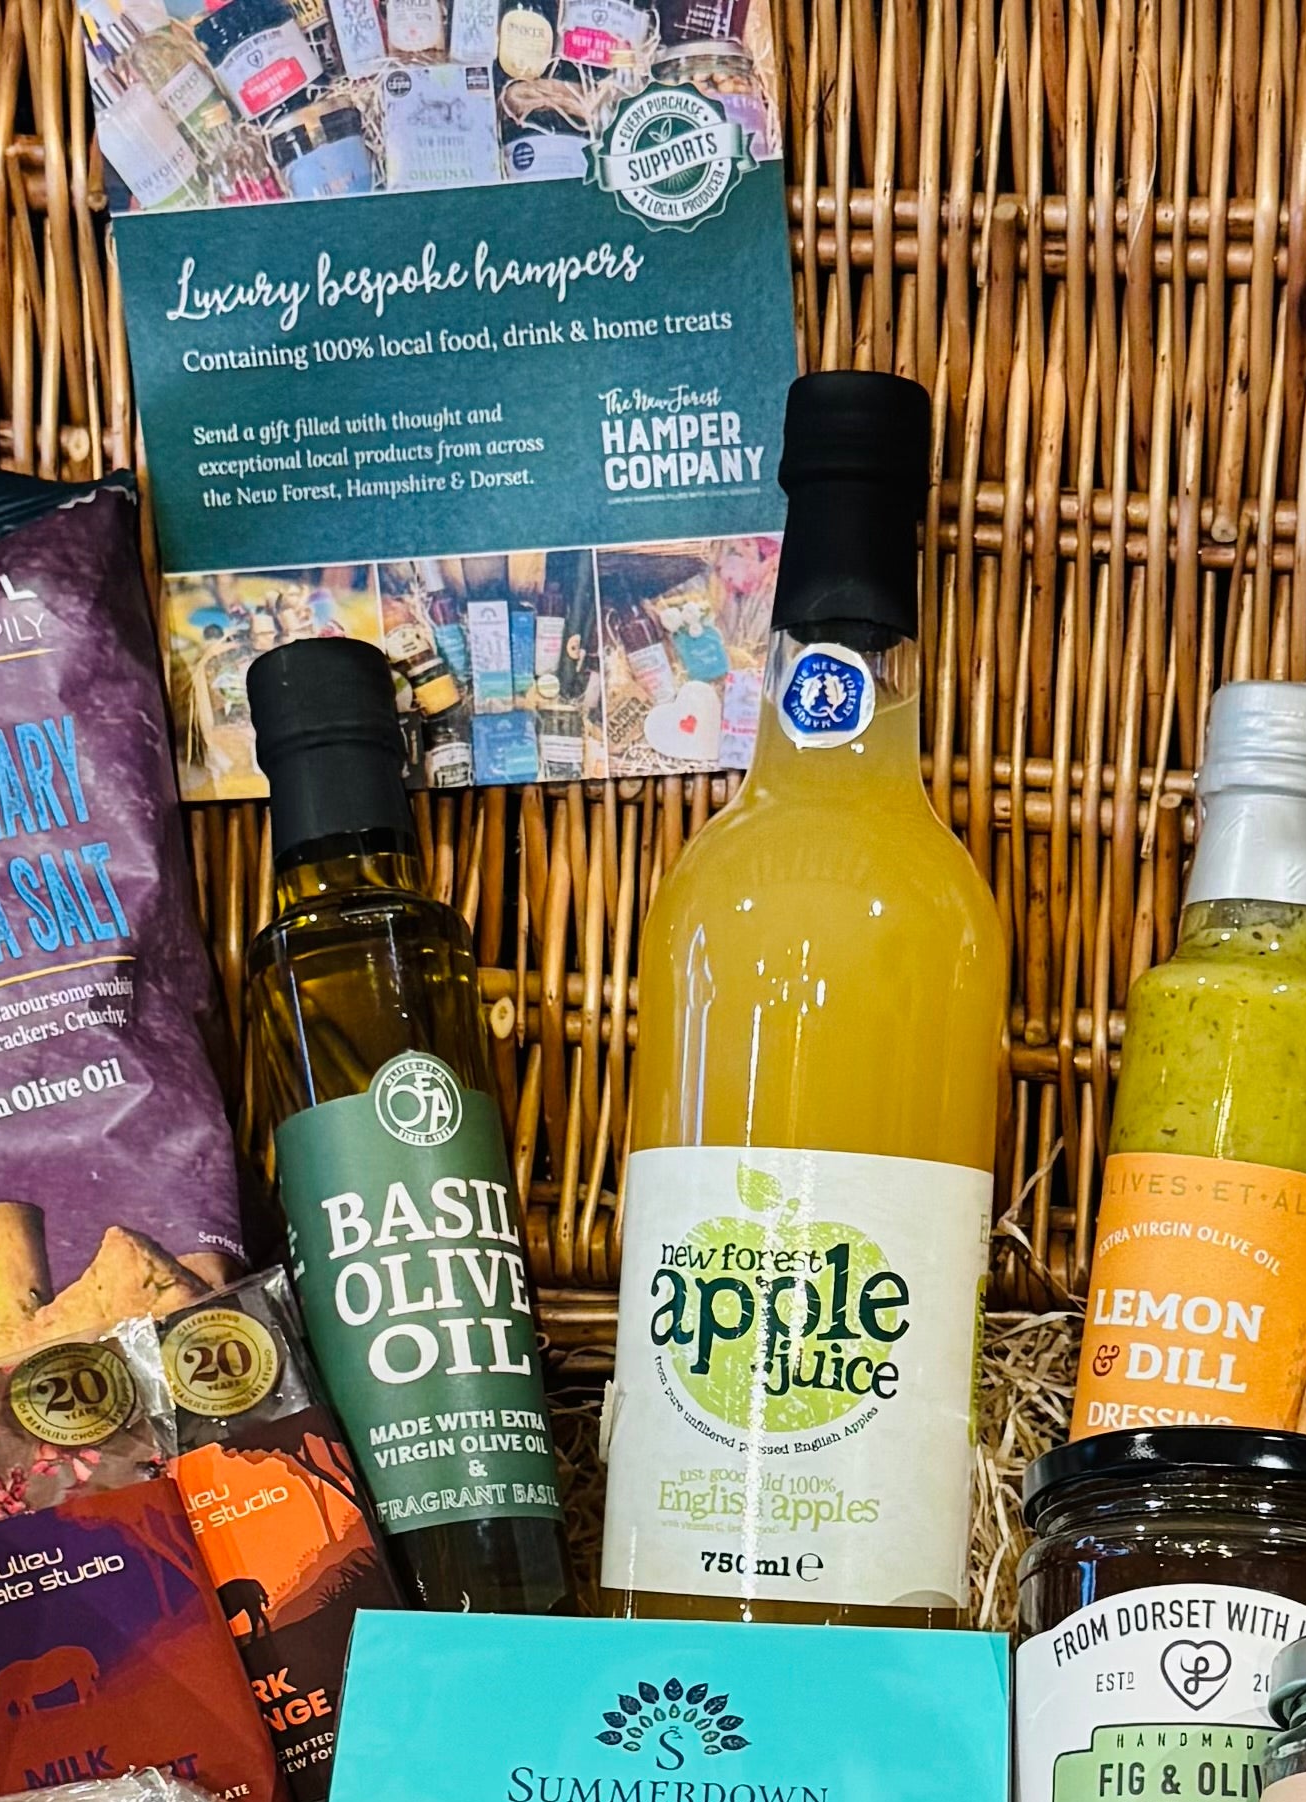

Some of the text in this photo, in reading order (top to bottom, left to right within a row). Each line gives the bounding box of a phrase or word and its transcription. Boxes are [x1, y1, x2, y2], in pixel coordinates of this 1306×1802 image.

[628, 132, 717, 182] SUPPORTS
[167, 240, 644, 331] Luxury bespoke hampers
[183, 312, 732, 372] Containing 100% local food, drink & home treats
[194, 403, 502, 445] Send a gift filled with thought and
[601, 411, 741, 454] HAMPER
[605, 446, 765, 491] COMPANY
[19, 843, 131, 956] SALT
[11, 1075, 83, 1114] Olive
[82, 1058, 126, 1091] Oil
[320, 1176, 522, 1261] BASIL
[660, 1242, 823, 1273] new forest
[1098, 1220, 1281, 1277] EXTRA VIRGIN OLIVE OIL
[335, 1247, 532, 1327] OLIVE
[650, 1242, 910, 1376] apple
[1093, 1288, 1265, 1343] LEMON
[368, 1317, 532, 1384] OIL
[761, 1338, 900, 1400] juice
[1092, 1342, 1248, 1394] & DILL
[39, 1551, 125, 1591] studio
